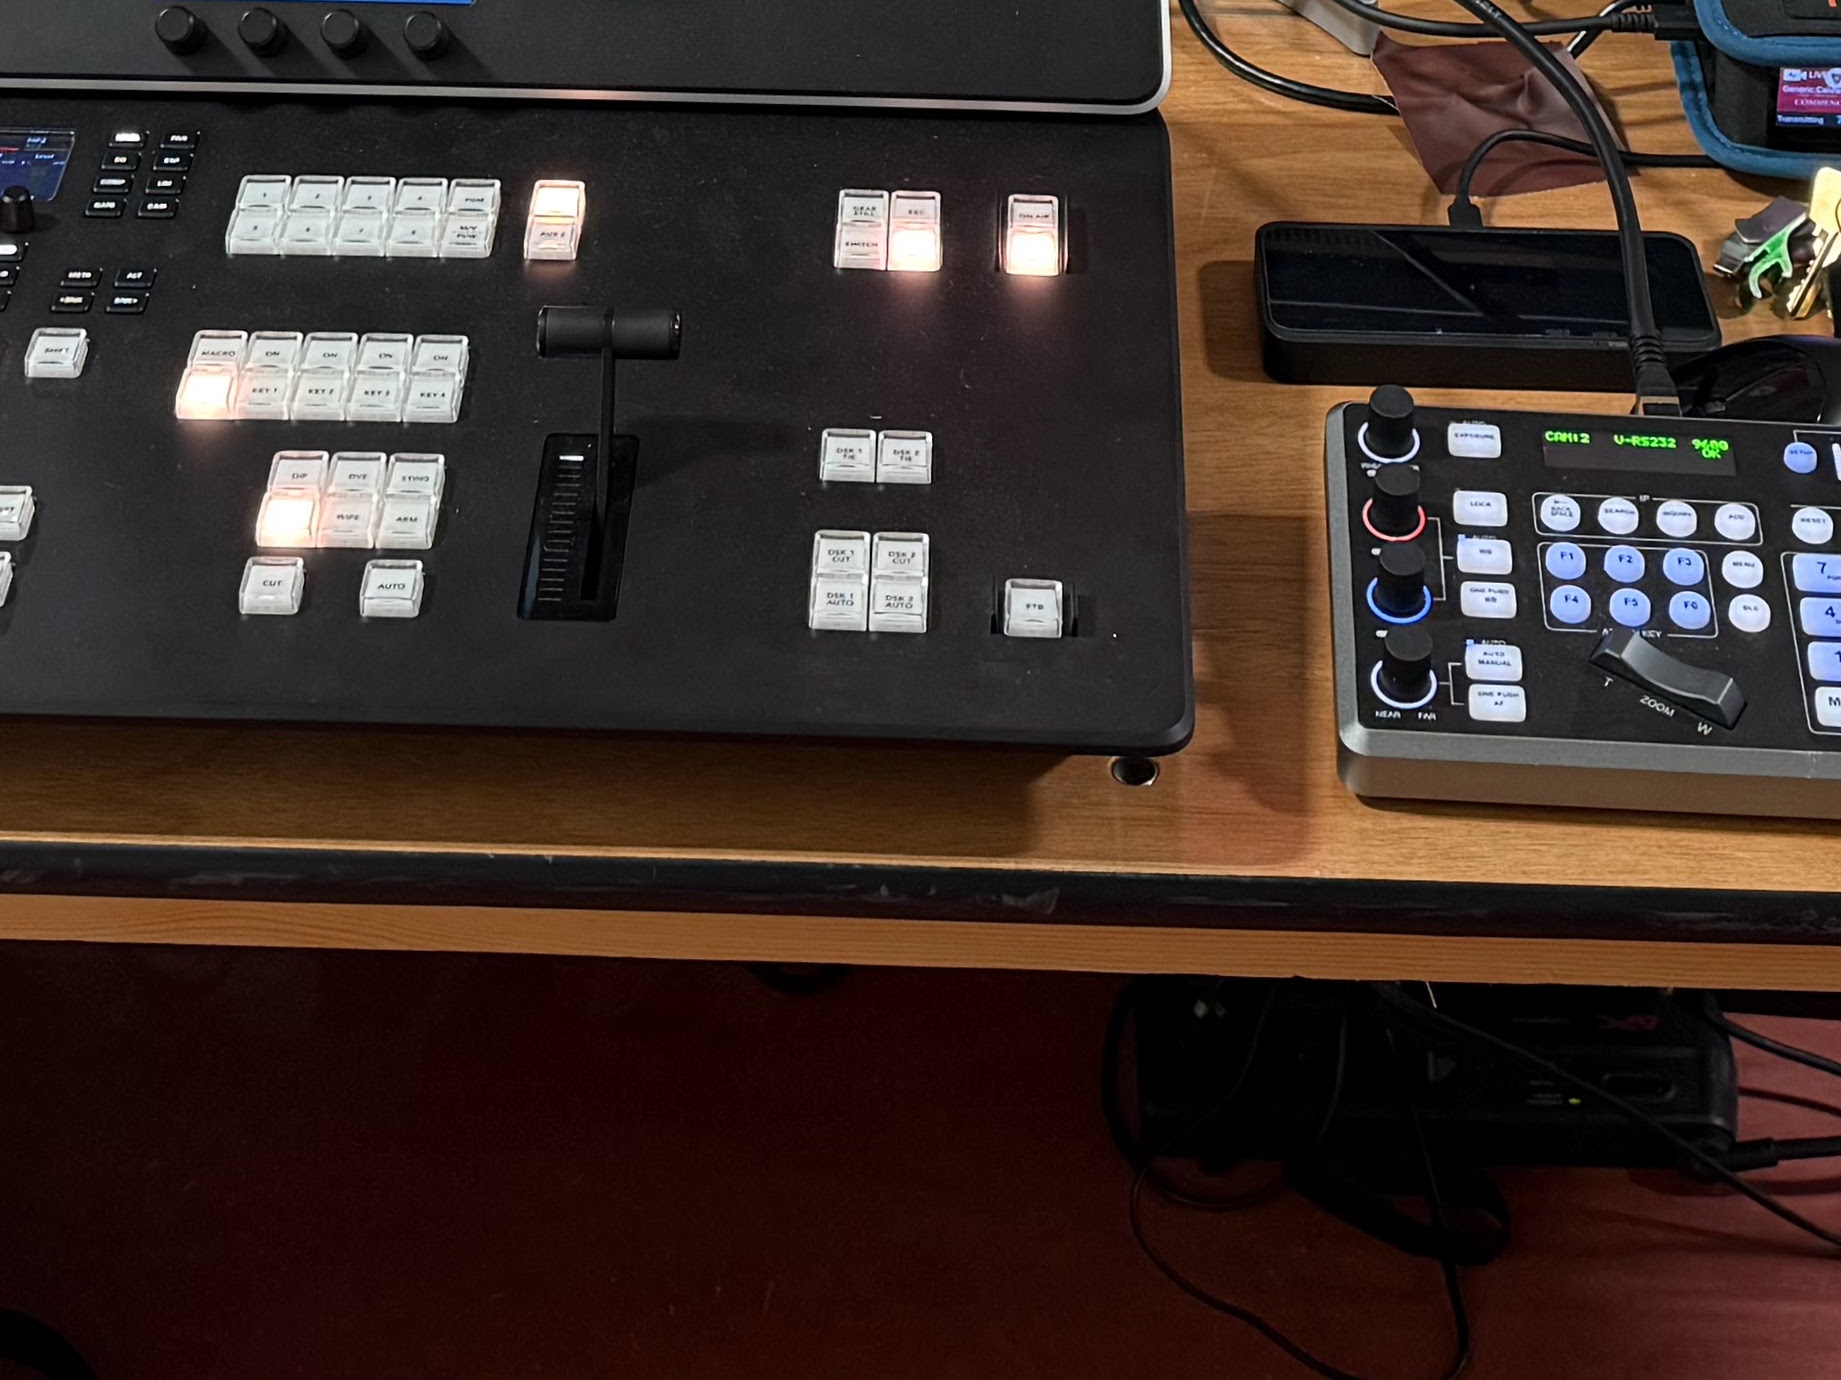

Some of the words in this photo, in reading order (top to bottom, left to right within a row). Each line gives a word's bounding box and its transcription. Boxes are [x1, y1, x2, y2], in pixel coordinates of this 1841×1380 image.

[1702, 449, 1721, 459] OK
[1560, 552, 1574, 560] F1
[1618, 554, 1633, 563] F2
[1817, 562, 1827, 574] 7
[262, 579, 282, 587] CUT
[377, 582, 406, 590] AUTO
[1564, 595, 1579, 603] F4
[1825, 606, 1836, 618] 4
[1639, 695, 1676, 718] ZOOM
